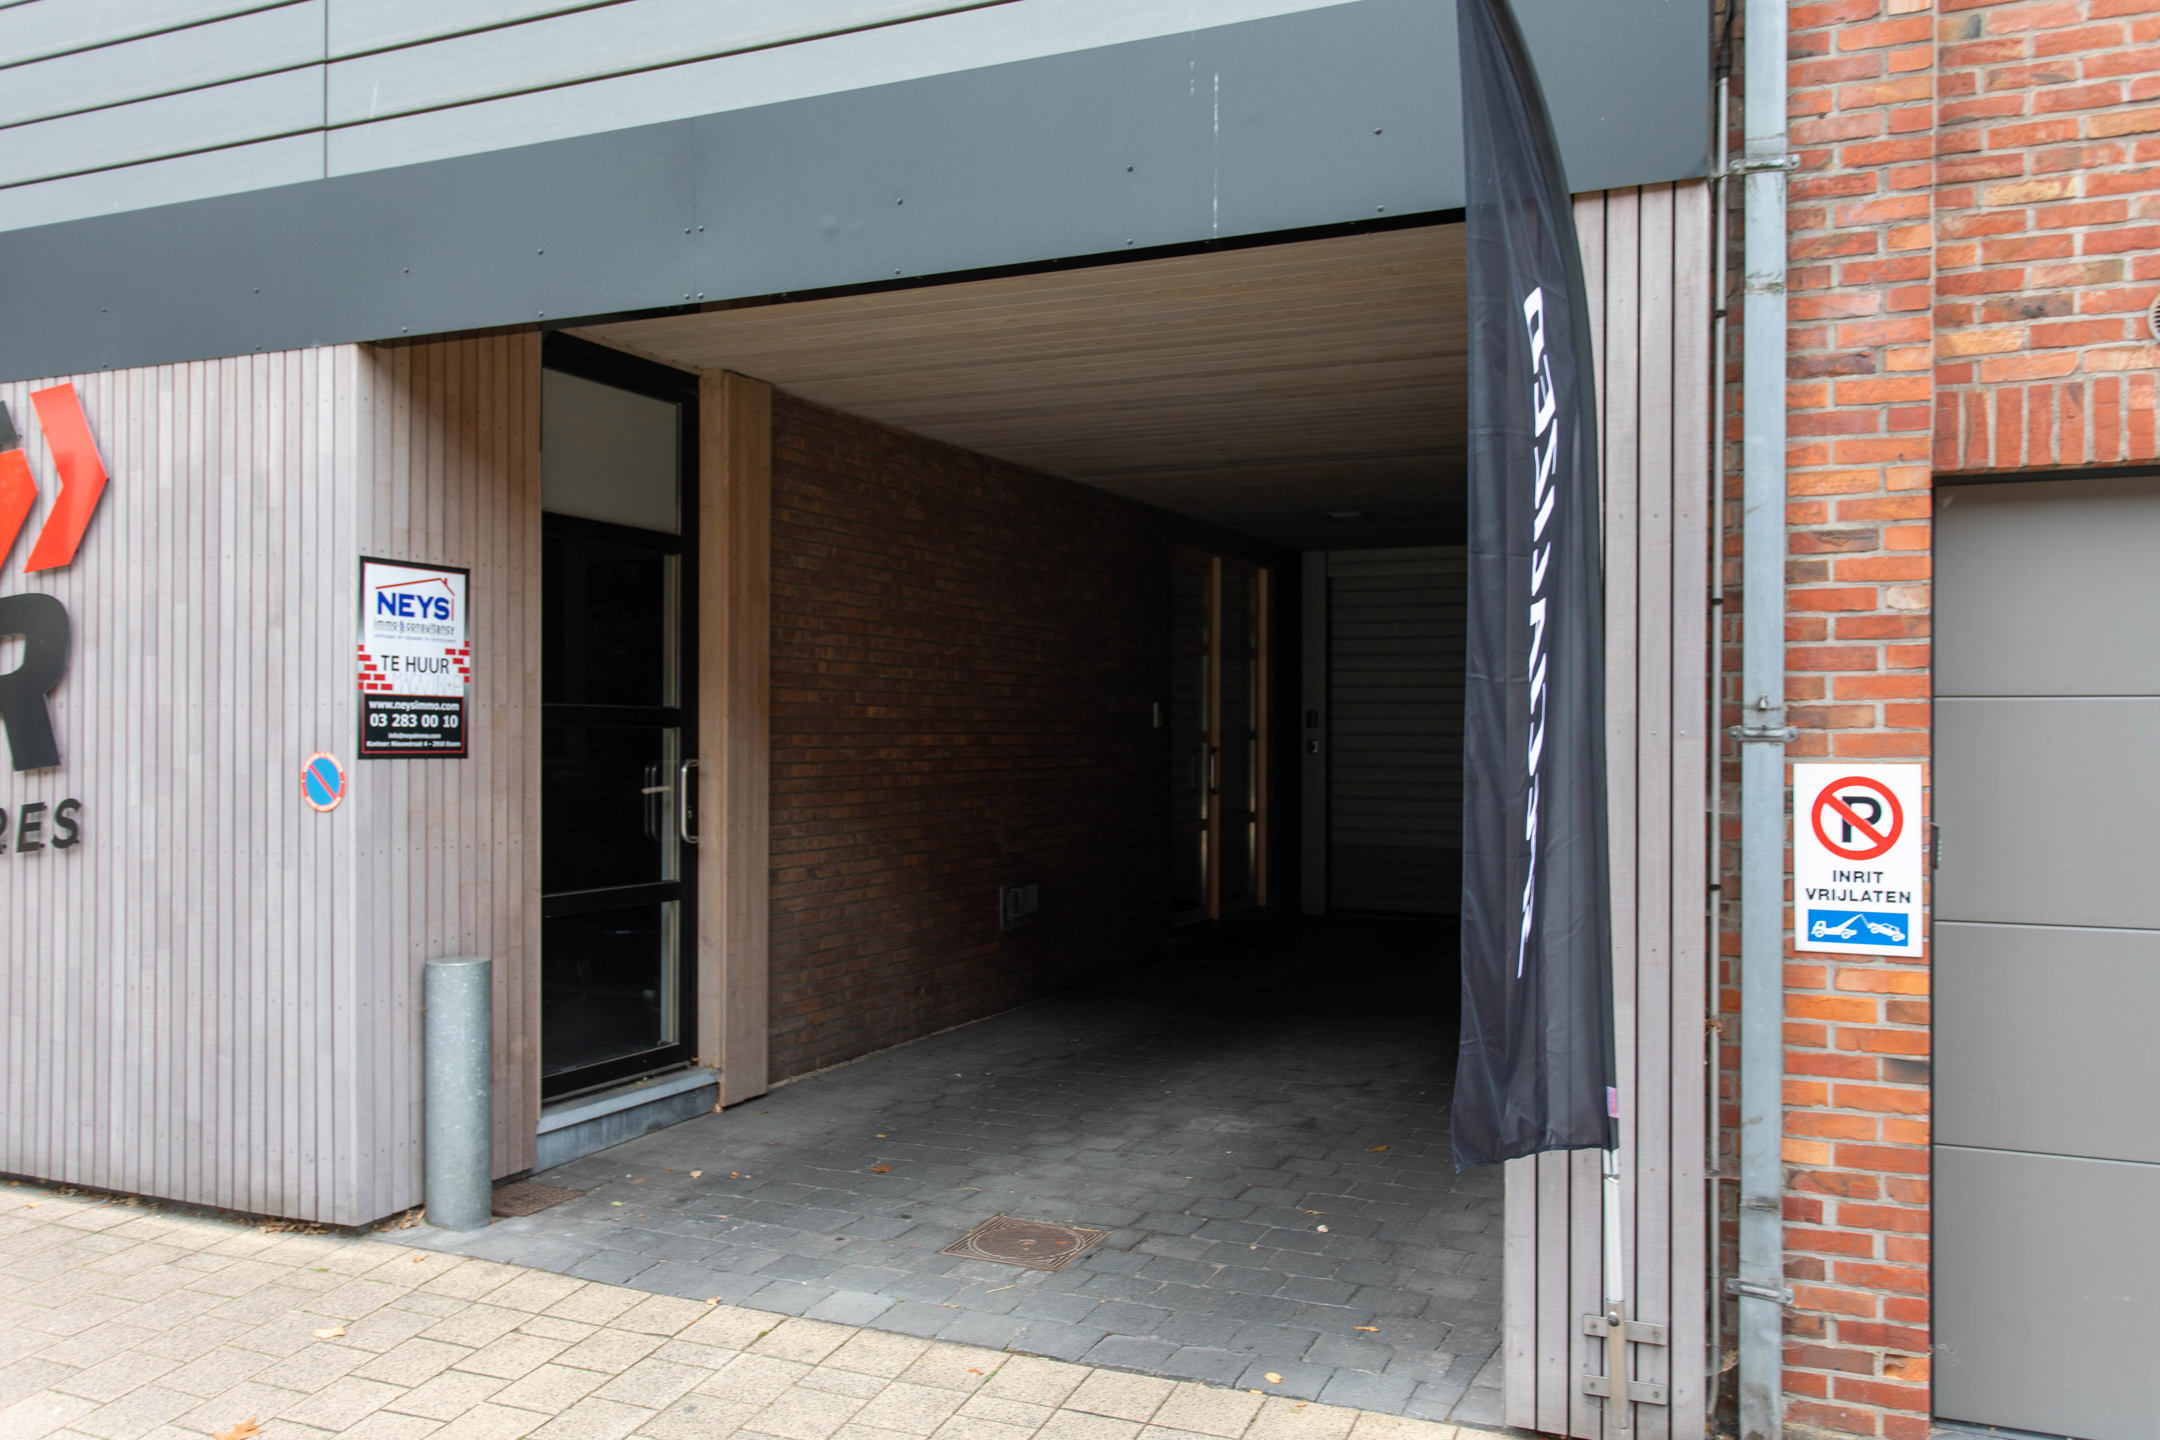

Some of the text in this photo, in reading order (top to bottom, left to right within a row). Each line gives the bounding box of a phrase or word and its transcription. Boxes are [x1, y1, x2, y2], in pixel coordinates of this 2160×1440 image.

[377, 592, 450, 621] NEYS
[381, 654, 450, 675] TE HUUR
[368, 700, 460, 712] www.neysimmo.com
[369, 713, 459, 728] 03 283 00 10
[0, 797, 82, 855] ES
[1841, 796, 1882, 843] P
[1832, 870, 1884, 884] INRIT
[1806, 888, 1911, 904] VRIJLATEN
